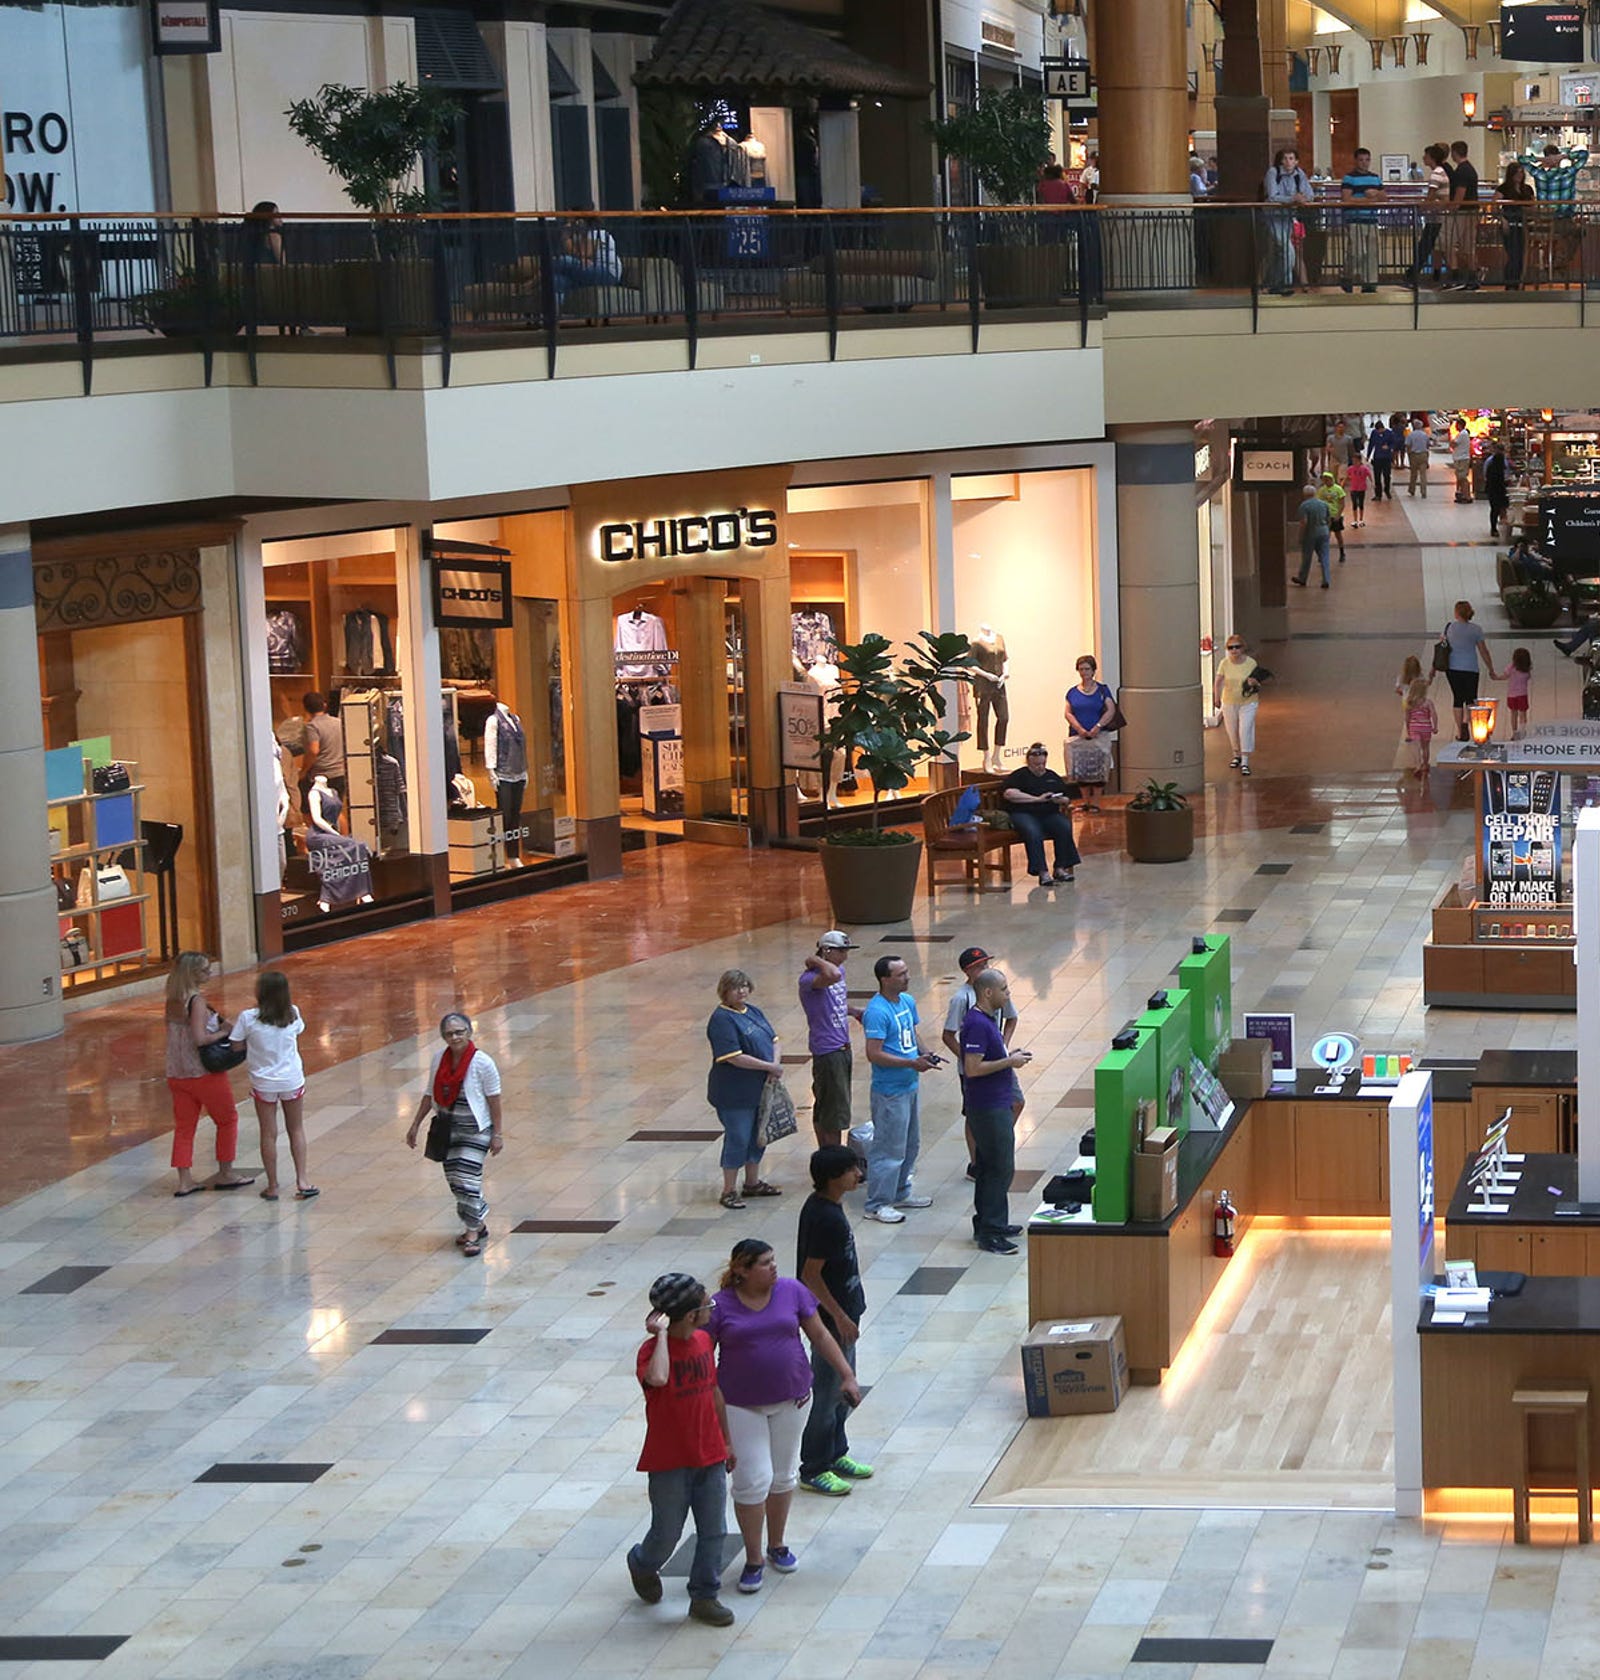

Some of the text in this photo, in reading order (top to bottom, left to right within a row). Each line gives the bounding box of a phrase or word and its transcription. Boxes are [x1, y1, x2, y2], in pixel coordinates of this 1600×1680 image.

[1057, 74, 1078, 92] AE
[1246, 461, 1290, 470] COACH
[1565, 519, 1596, 527] Children's
[599, 506, 778, 562] CHICO'S
[441, 587, 502, 603] CHICO'S
[1523, 744, 1576, 756] PHONE
[1485, 814, 1560, 827] CELL PHONE
[1489, 826, 1555, 841] REPAIR
[322, 861, 369, 883] CHICO'S
[1490, 880, 1556, 893] ANY MAKE
[1489, 892, 1557, 904] OR MODEL!
[281, 905, 298, 918] 370
[1031, 1349, 1046, 1398] MEDIUM
